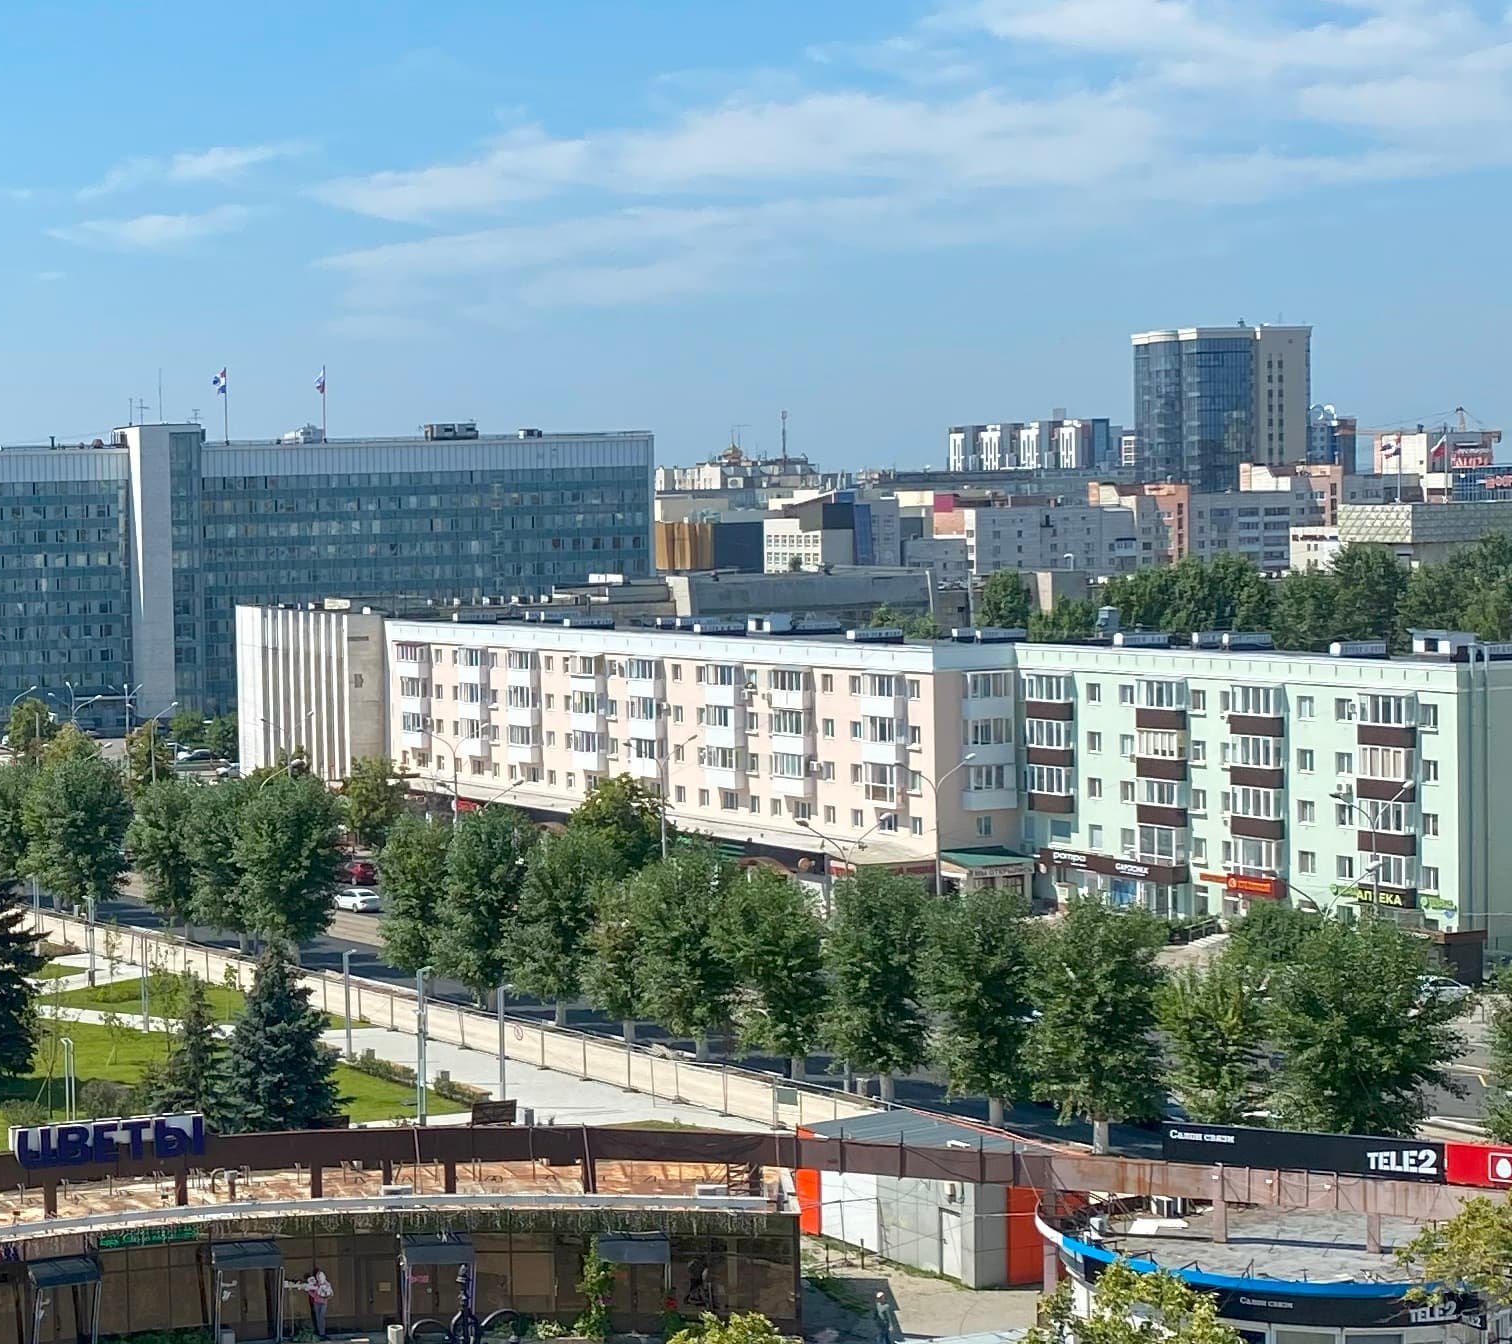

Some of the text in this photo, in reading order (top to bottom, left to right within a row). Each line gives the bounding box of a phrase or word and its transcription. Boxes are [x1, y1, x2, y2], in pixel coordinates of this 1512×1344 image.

[1357, 891, 1403, 906] АПЕКА
[16, 1113, 205, 1170] ЦВЕТЫ
[1366, 1149, 1437, 1175] TELE2
[1409, 1300, 1457, 1323] TELE2
